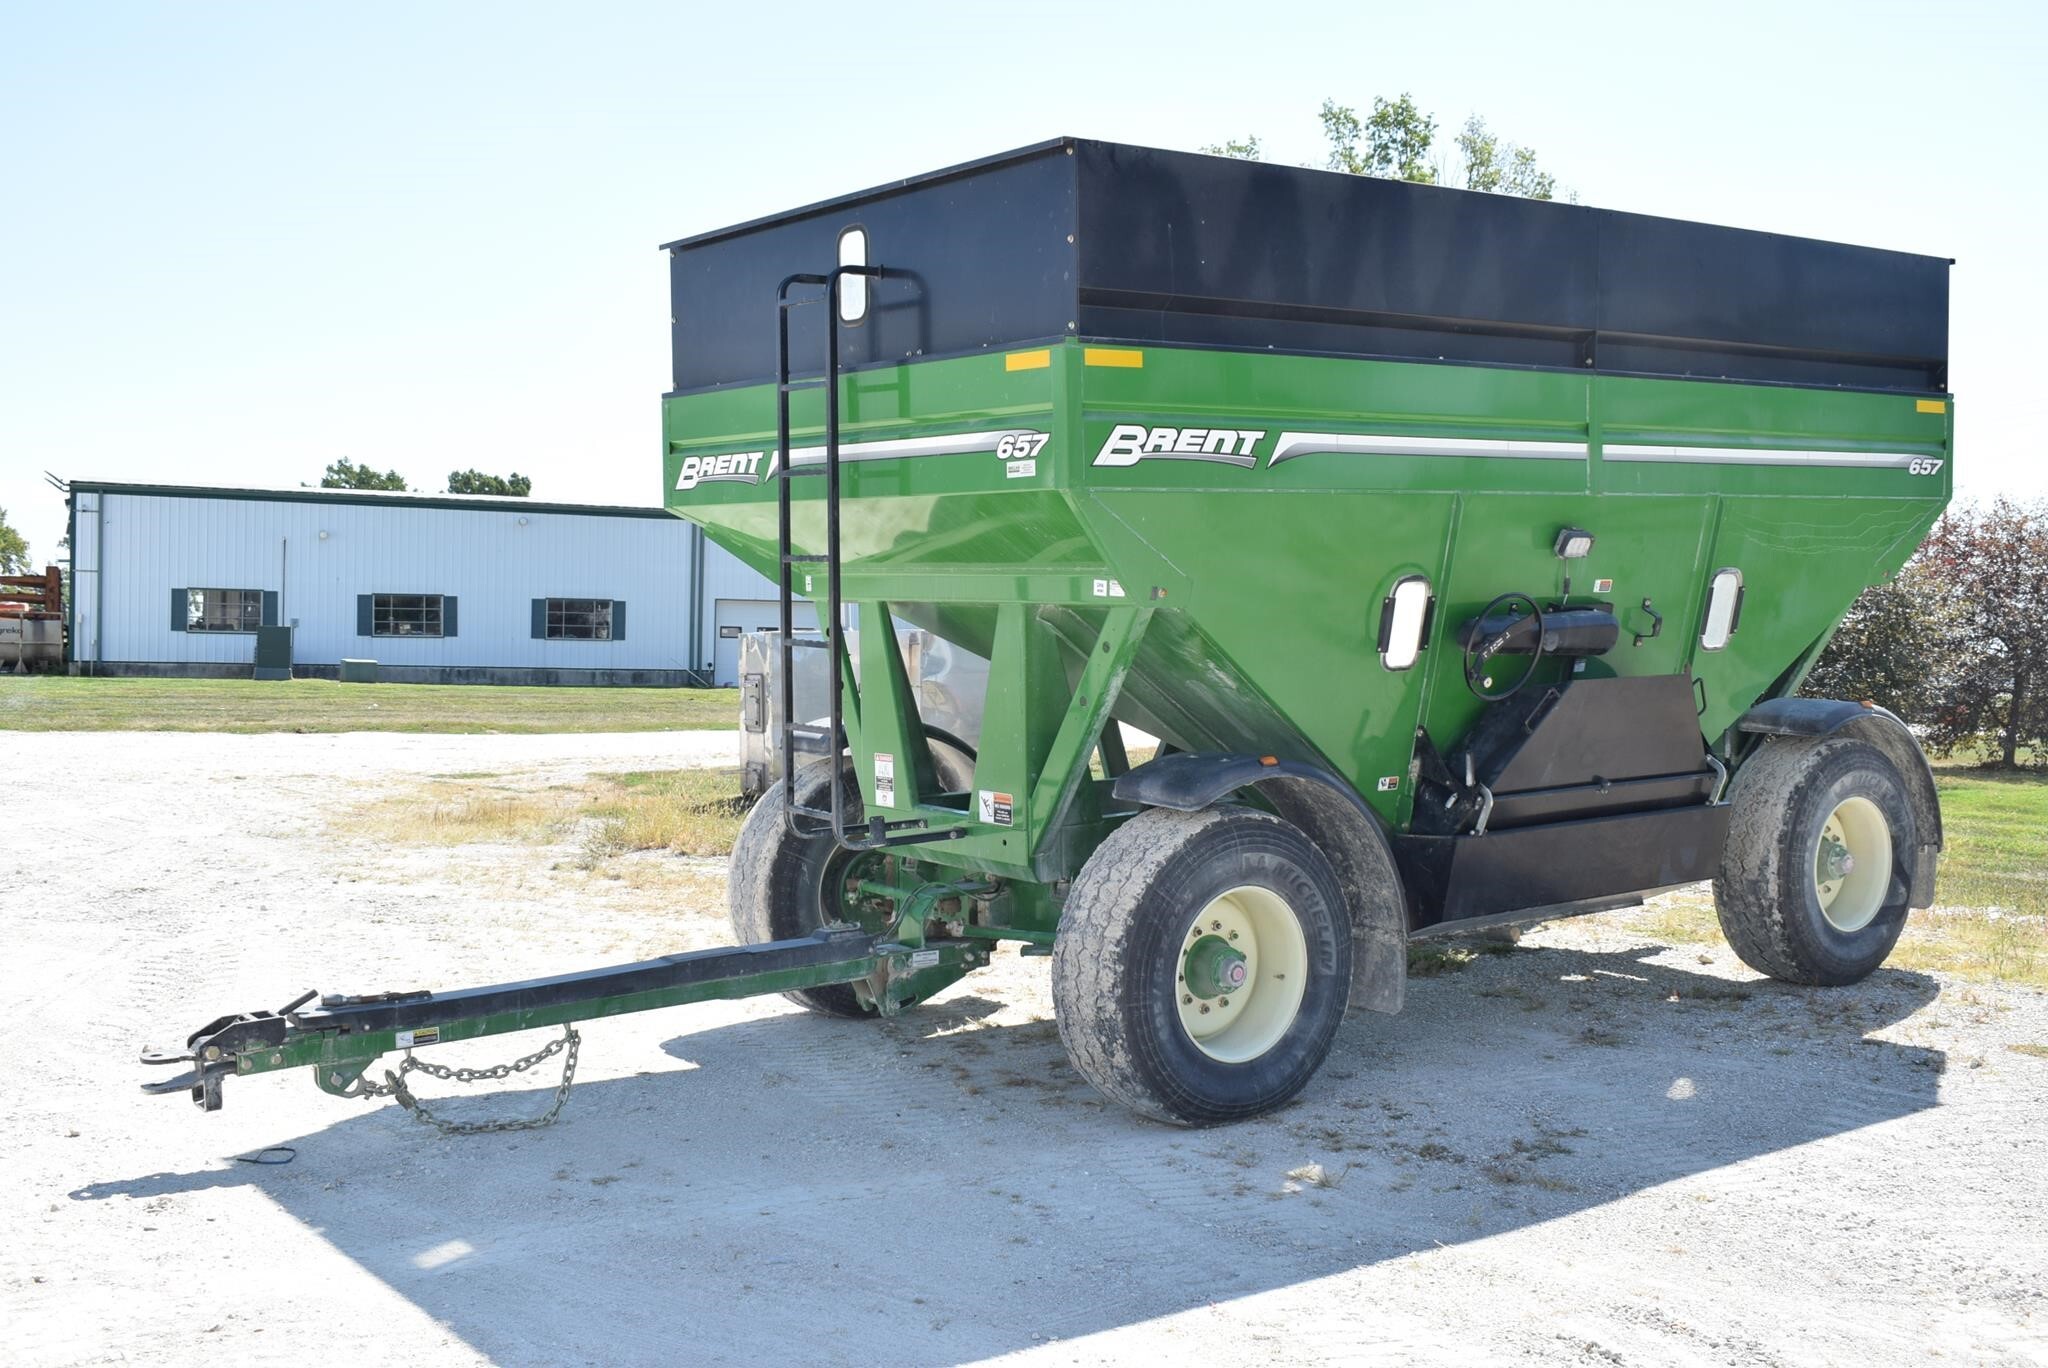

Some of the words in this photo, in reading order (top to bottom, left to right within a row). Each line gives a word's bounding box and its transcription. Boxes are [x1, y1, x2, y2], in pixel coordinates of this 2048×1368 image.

[996, 432, 1051, 460] 657
[1091, 424, 1267, 467] BRENT
[674, 451, 765, 490] BRENT
[1908, 457, 1944, 476] 657
[1272, 861, 1336, 974] MICHELIN
